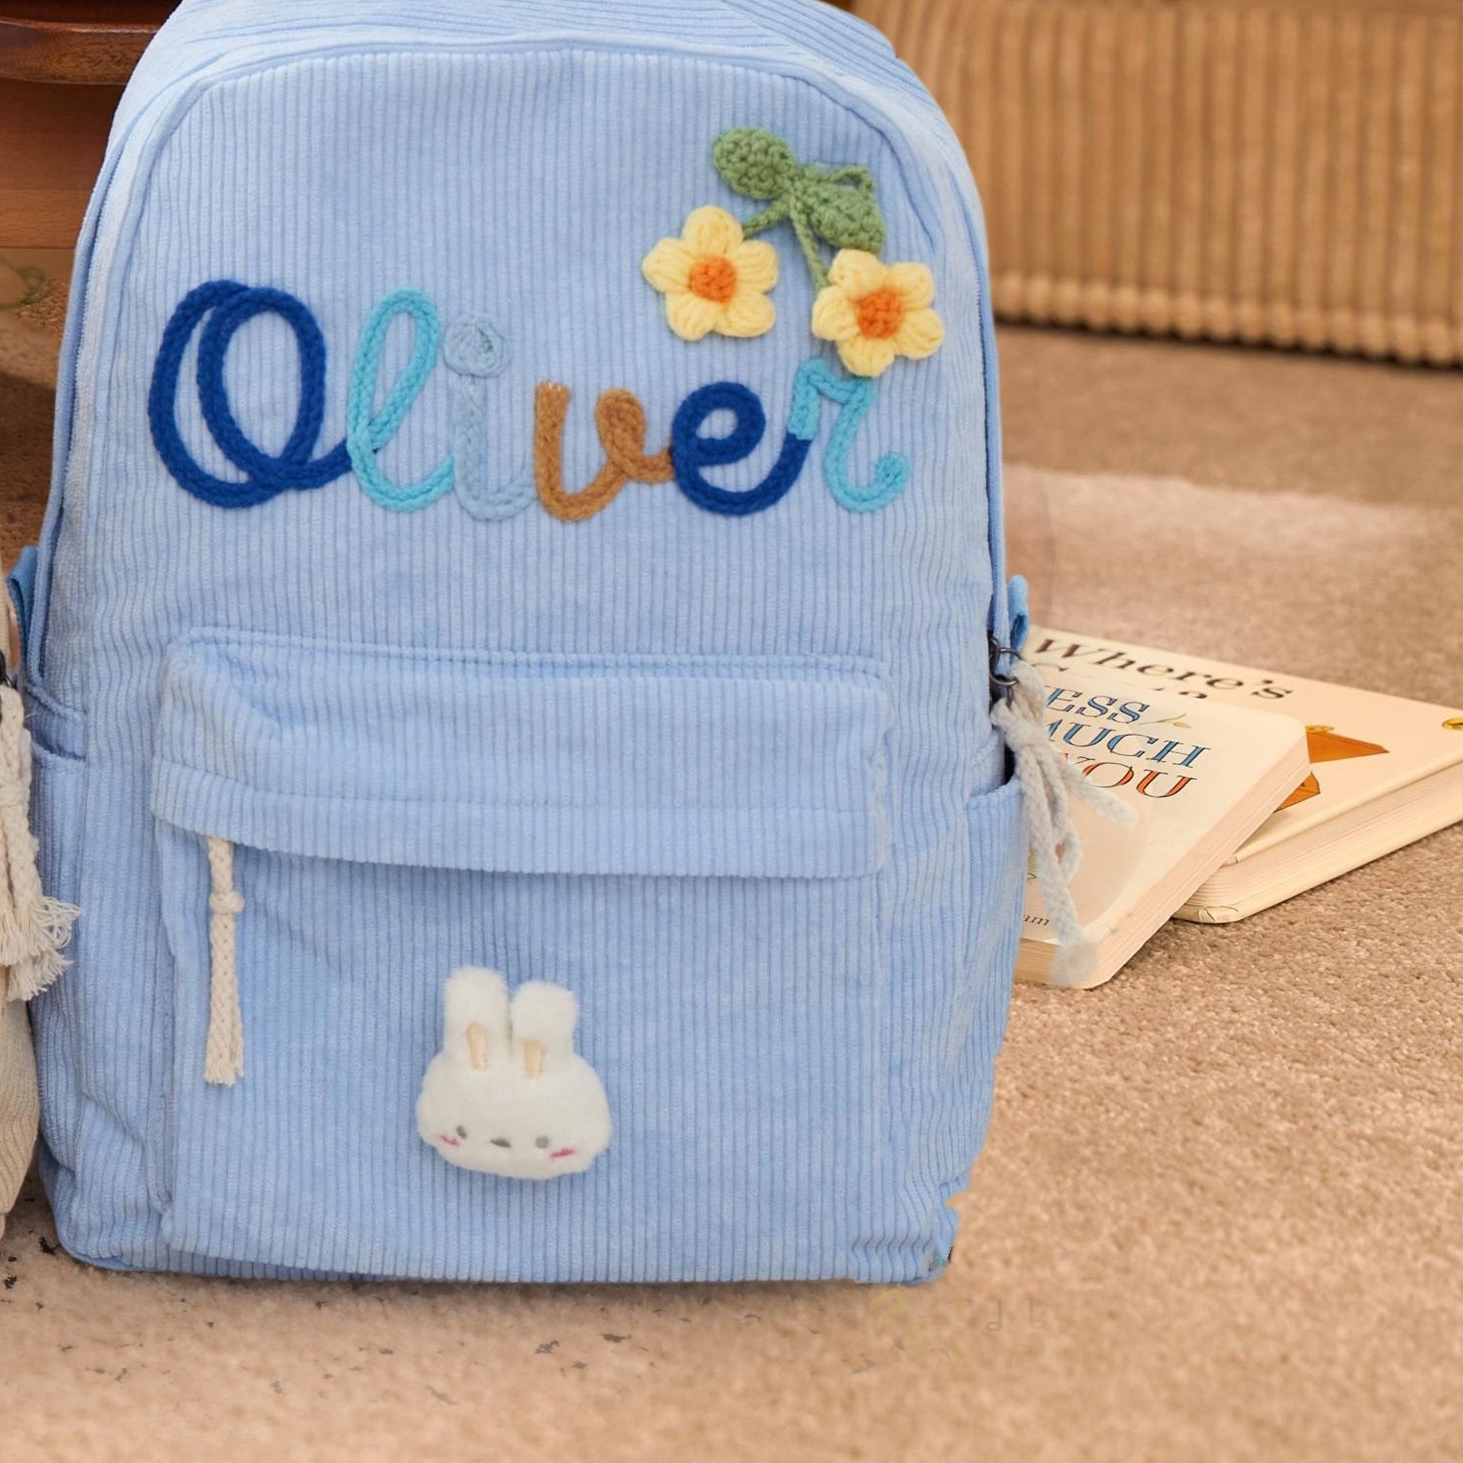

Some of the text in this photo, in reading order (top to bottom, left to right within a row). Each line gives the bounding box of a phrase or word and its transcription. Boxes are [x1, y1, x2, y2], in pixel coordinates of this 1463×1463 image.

[148, 280, 911, 522] Oliver
[1035, 639, 1293, 699] Where's
[1061, 752, 1197, 798] OU
